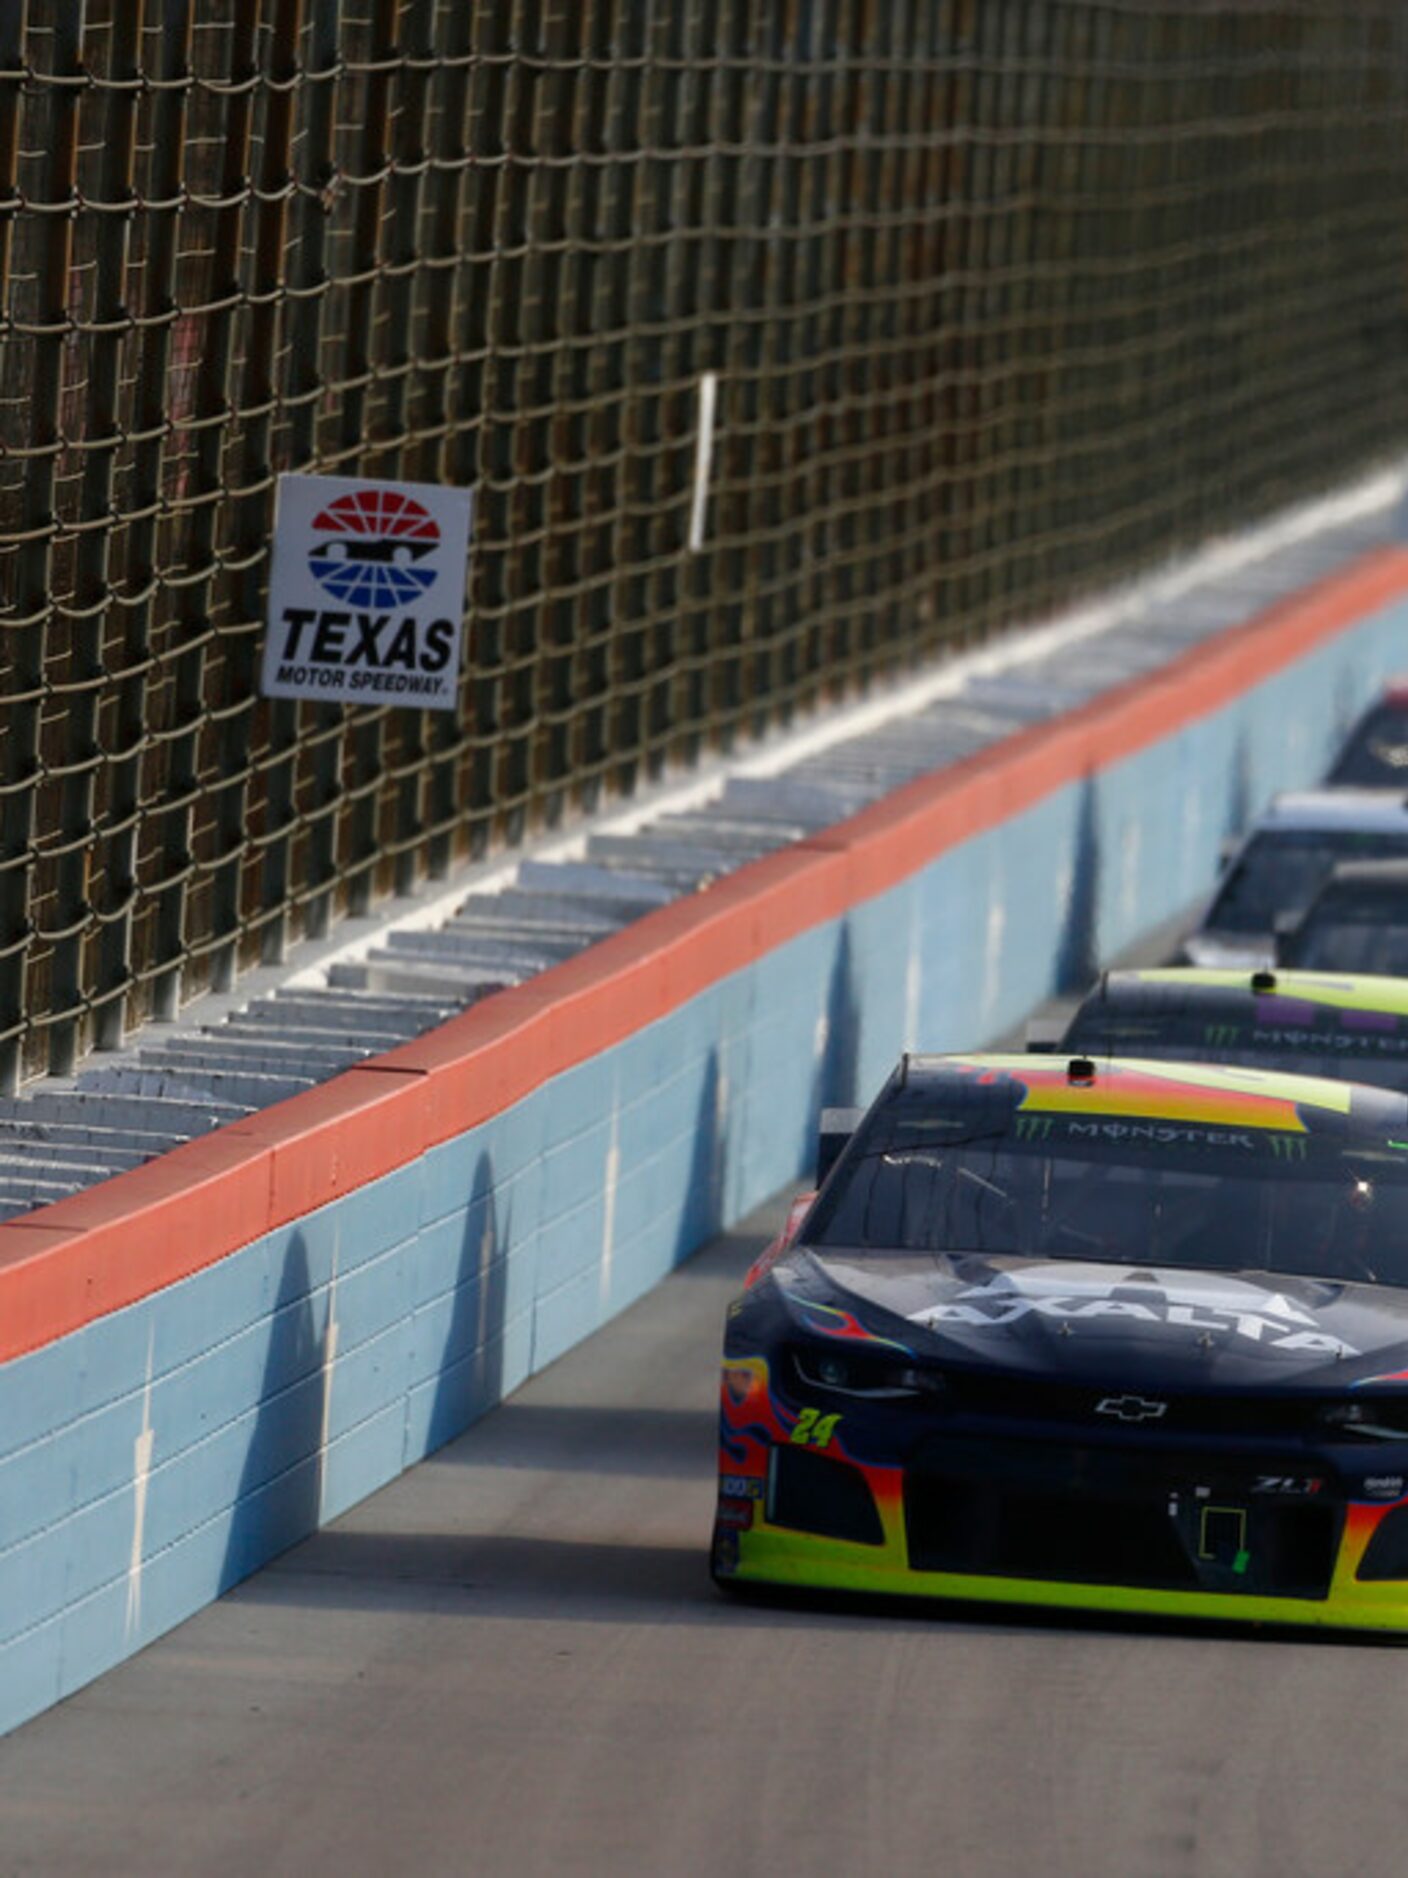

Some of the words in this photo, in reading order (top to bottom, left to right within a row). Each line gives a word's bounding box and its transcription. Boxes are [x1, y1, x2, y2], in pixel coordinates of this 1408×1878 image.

[282, 608, 455, 673] TEXAS
[275, 665, 345, 690] MOTOR
[348, 669, 445, 696] SPEEDWAY
[1067, 1120, 1255, 1148] MONSTER
[906, 1296, 1362, 1356] AXALTA
[790, 1407, 845, 1448] 24
